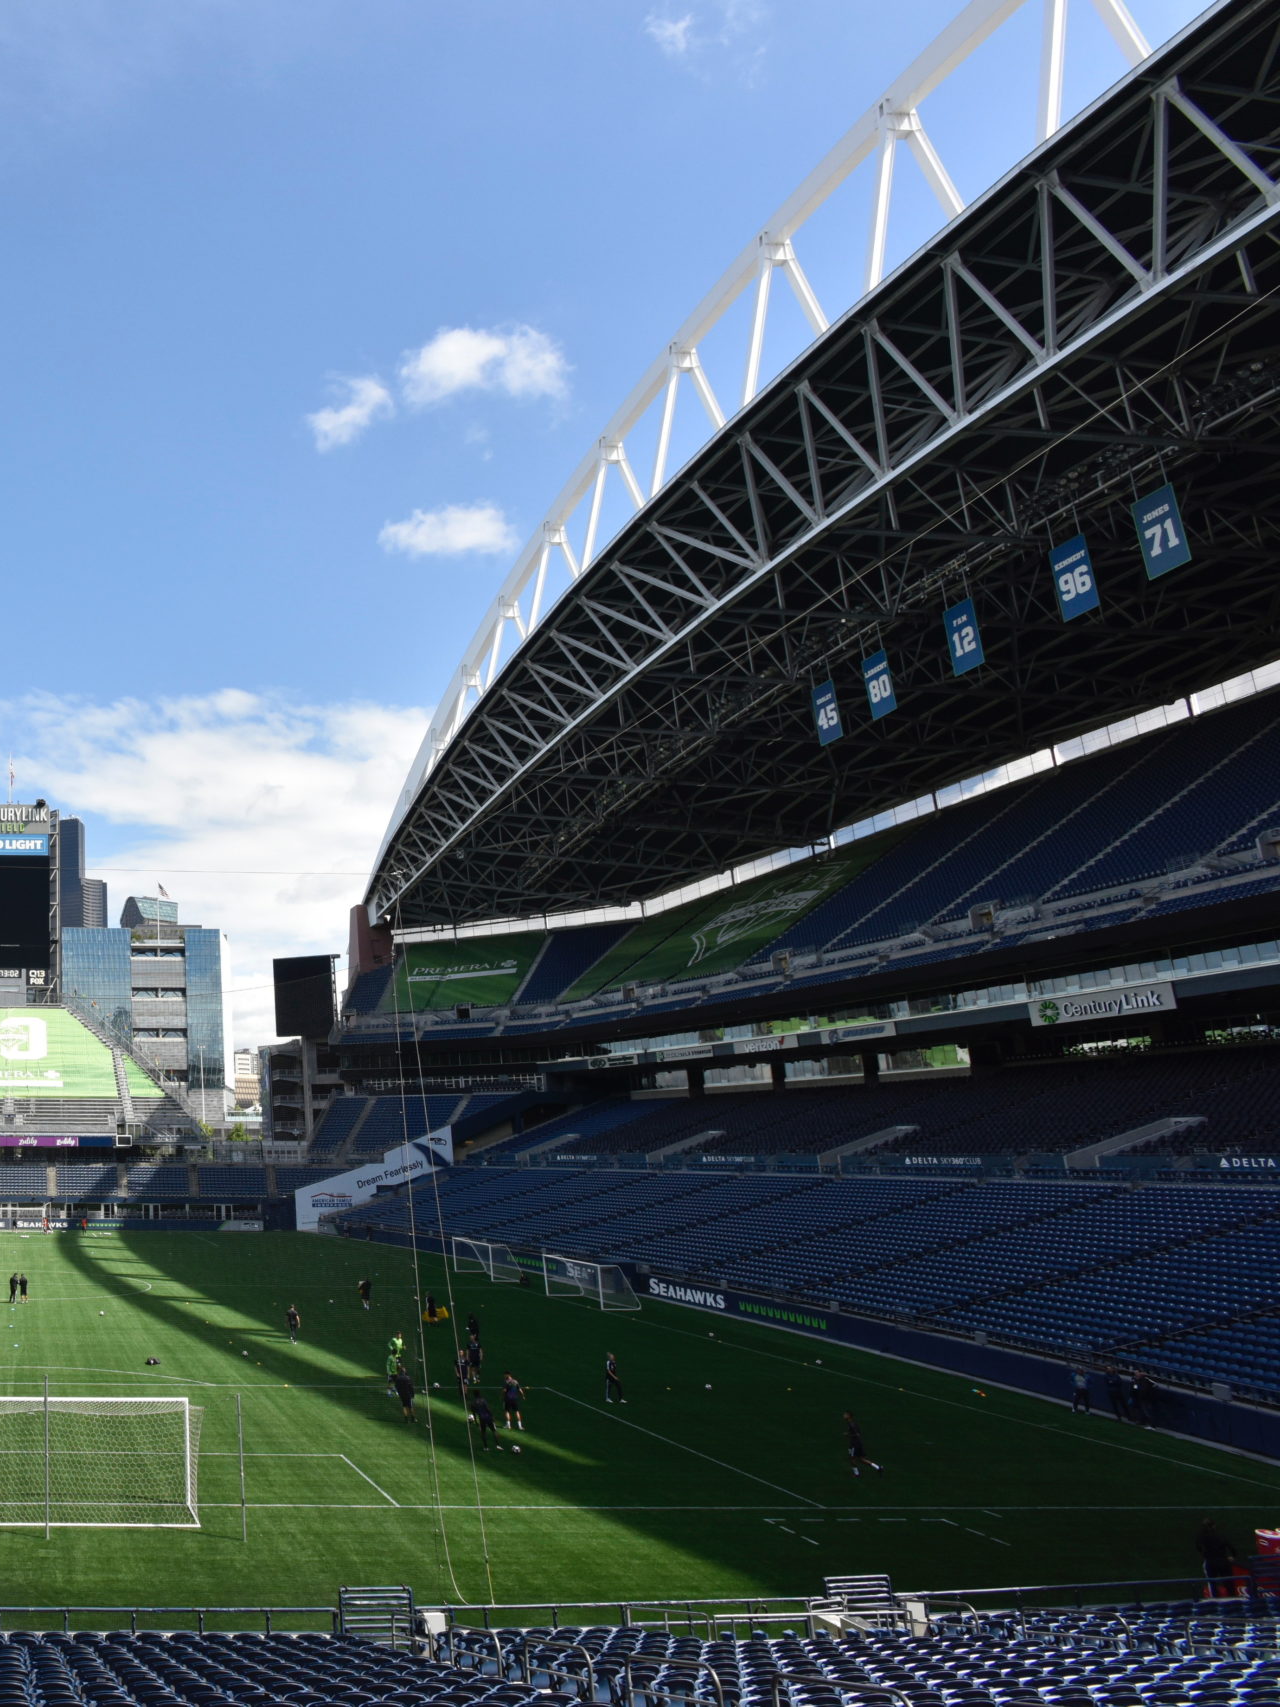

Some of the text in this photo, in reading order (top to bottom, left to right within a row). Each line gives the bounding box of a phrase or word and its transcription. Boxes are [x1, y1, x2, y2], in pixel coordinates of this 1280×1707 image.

[1142, 503, 1170, 524] JONES
[1144, 517, 1180, 558] 71
[1054, 549, 1085, 572] KENNEDY
[1058, 564, 1092, 602] 96
[953, 614, 968, 627] FAN
[953, 625, 977, 658] 12
[869, 674, 891, 703] 80
[818, 702, 838, 730] 45
[5, 839, 44, 850] LIGHT
[29, 969, 46, 977] Q13
[412, 962, 490, 975] PREMERA
[29, 977, 45, 985] FOX
[1063, 990, 1162, 1017] CenturyLink
[743, 1040, 780, 1053] verizon
[912, 1156, 939, 1164] DELTA
[1231, 1157, 1276, 1168] DELTA
[356, 1159, 424, 1189] Dream Fearlessly
[16, 1220, 68, 1228] SEAHWKS
[649, 1277, 725, 1310] SEAHAWKS
